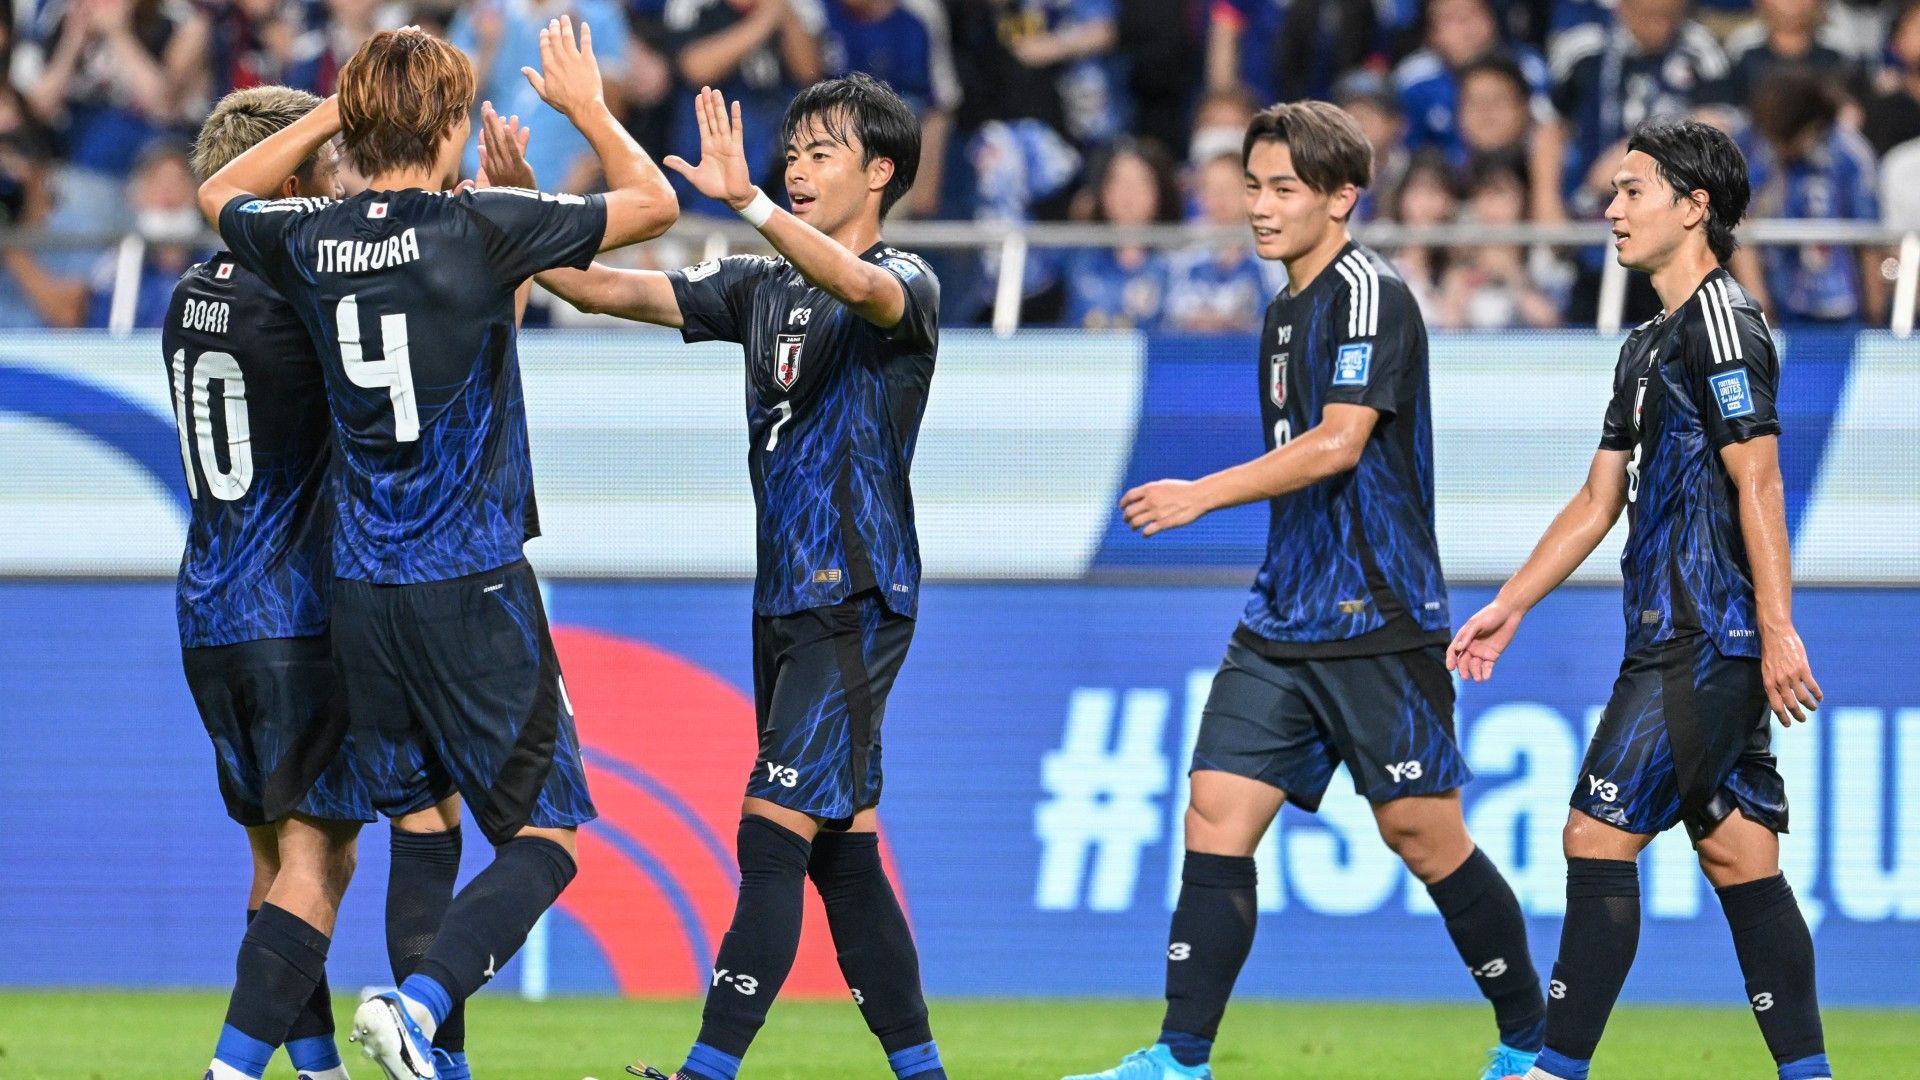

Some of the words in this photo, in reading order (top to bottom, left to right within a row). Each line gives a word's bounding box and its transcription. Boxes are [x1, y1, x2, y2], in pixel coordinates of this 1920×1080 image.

[316, 227, 420, 273] ITAKURA
[182, 298, 230, 333] DOAN
[788, 307, 812, 325] Y-3
[335, 293, 421, 442] 4
[172, 348, 254, 501] 10
[766, 400, 792, 451] 7
[767, 761, 799, 788] Y-3
[1384, 759, 1423, 783] Y-3
[1588, 774, 1619, 803] Y-3
[712, 968, 759, 996] Y-3
